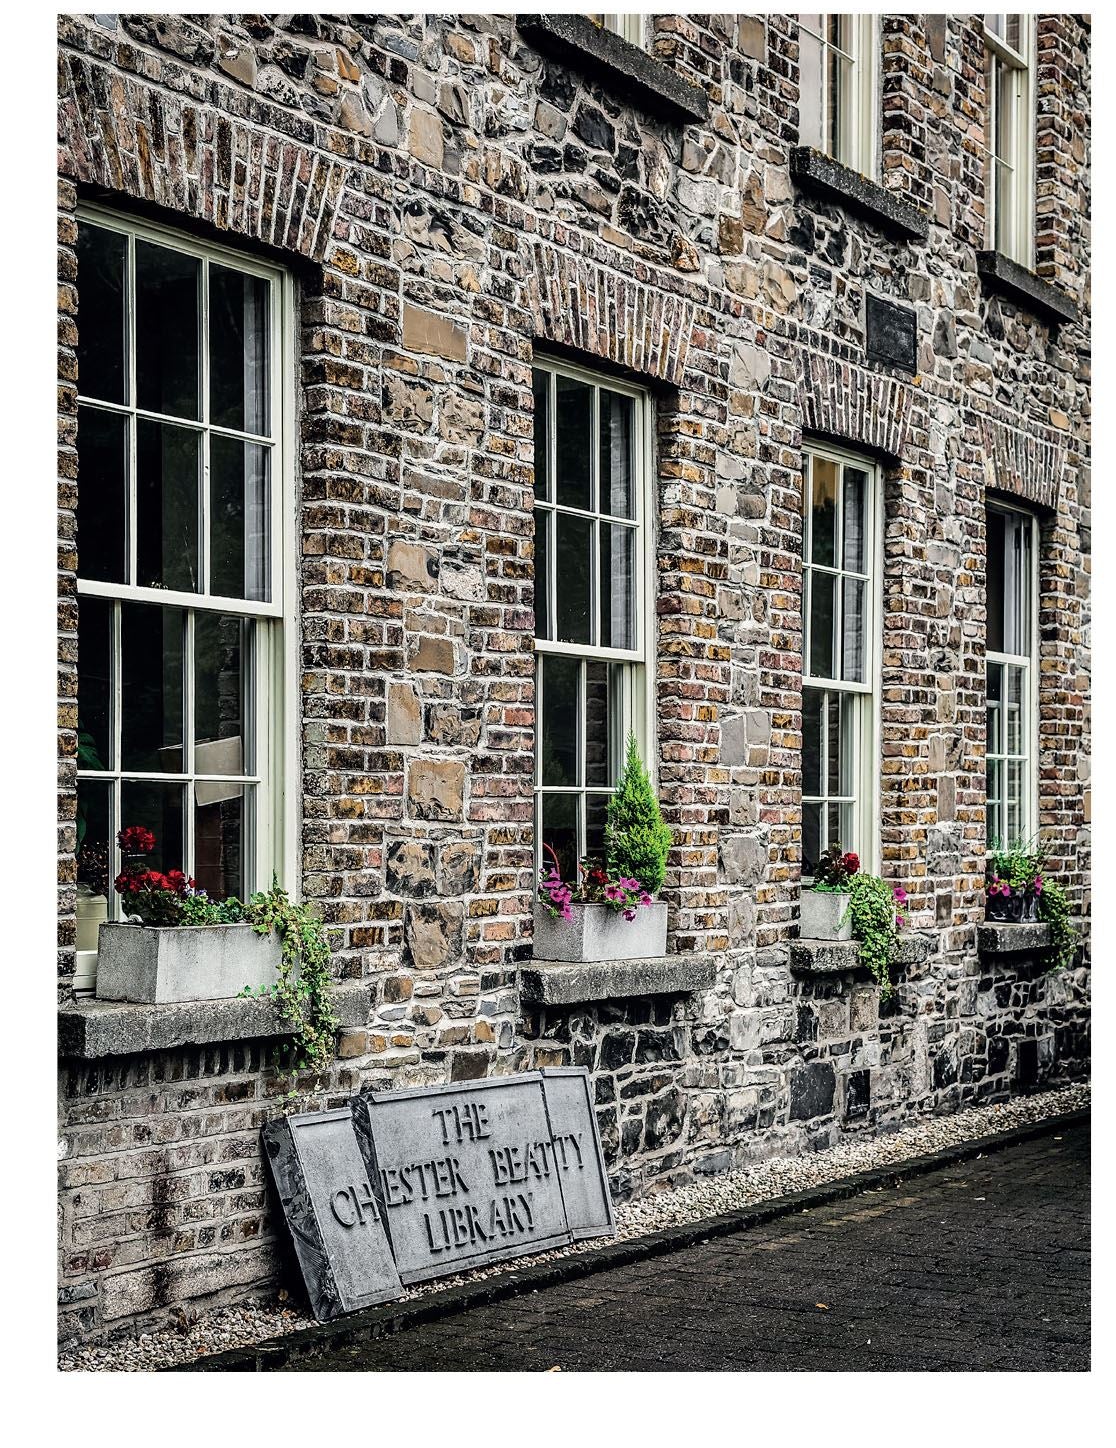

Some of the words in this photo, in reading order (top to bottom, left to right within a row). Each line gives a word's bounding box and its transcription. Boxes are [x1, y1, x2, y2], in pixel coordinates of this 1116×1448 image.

[432, 1103, 493, 1145] THE
[329, 1157, 470, 1228] CHESTER
[488, 1132, 585, 1187] BEATTY
[423, 1192, 536, 1254] LIBRARY
